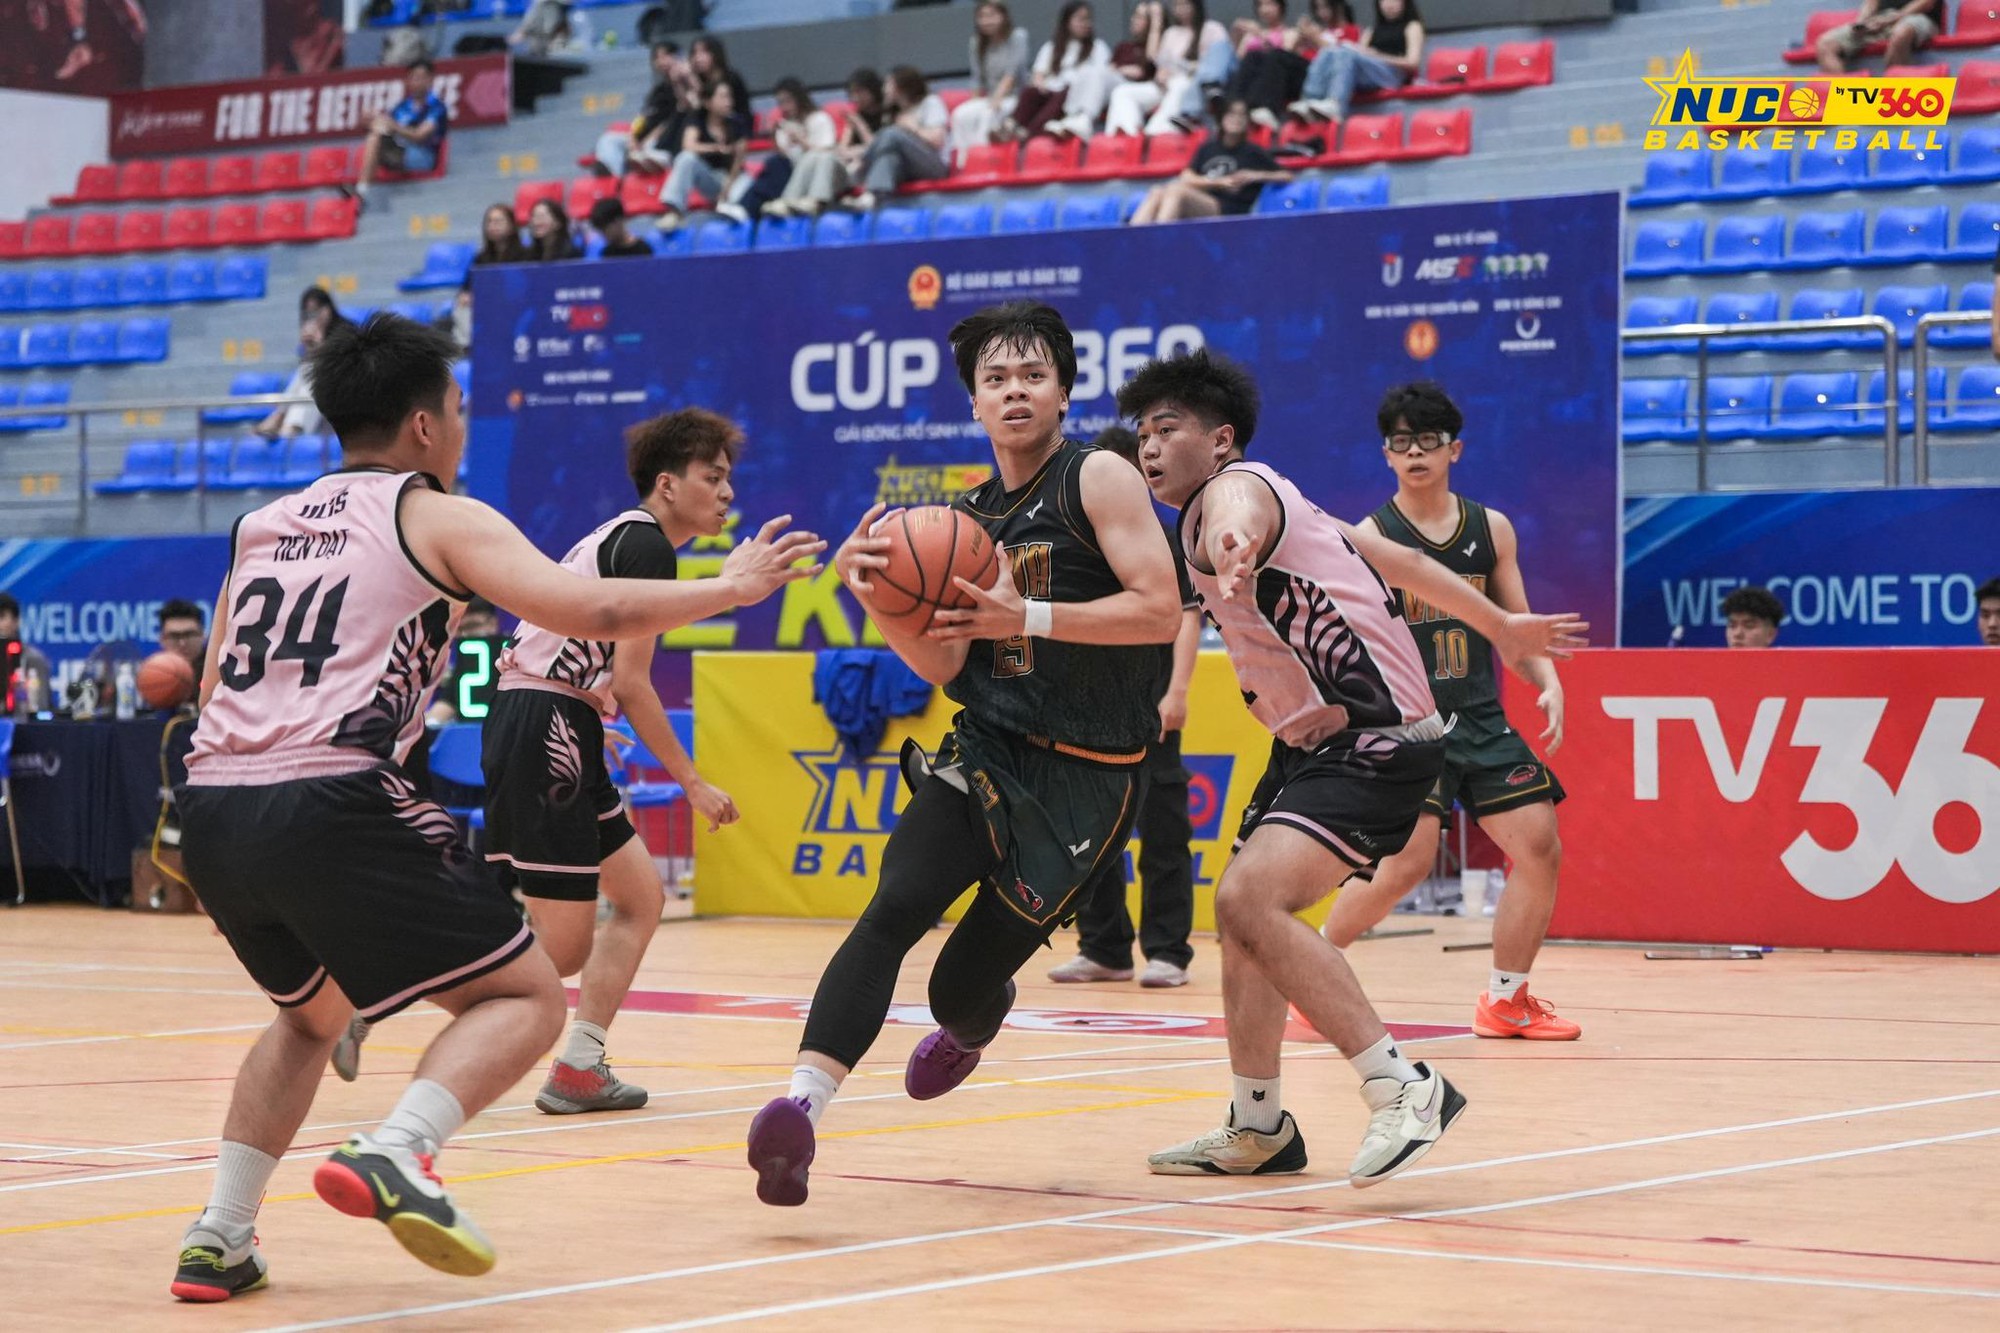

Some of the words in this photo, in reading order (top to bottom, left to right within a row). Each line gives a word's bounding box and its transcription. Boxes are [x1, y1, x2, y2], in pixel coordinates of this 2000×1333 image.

[215, 95, 263, 141] FOR
[269, 88, 315, 137] THE
[791, 330, 939, 411] CÚP
[20, 602, 163, 644] WELCOME
[1661, 576, 1899, 627] WECOME
[1910, 573, 1976, 626] TO
[219, 575, 350, 691] 34
[1433, 628, 1468, 680] 10
[459, 640, 492, 718] 2
